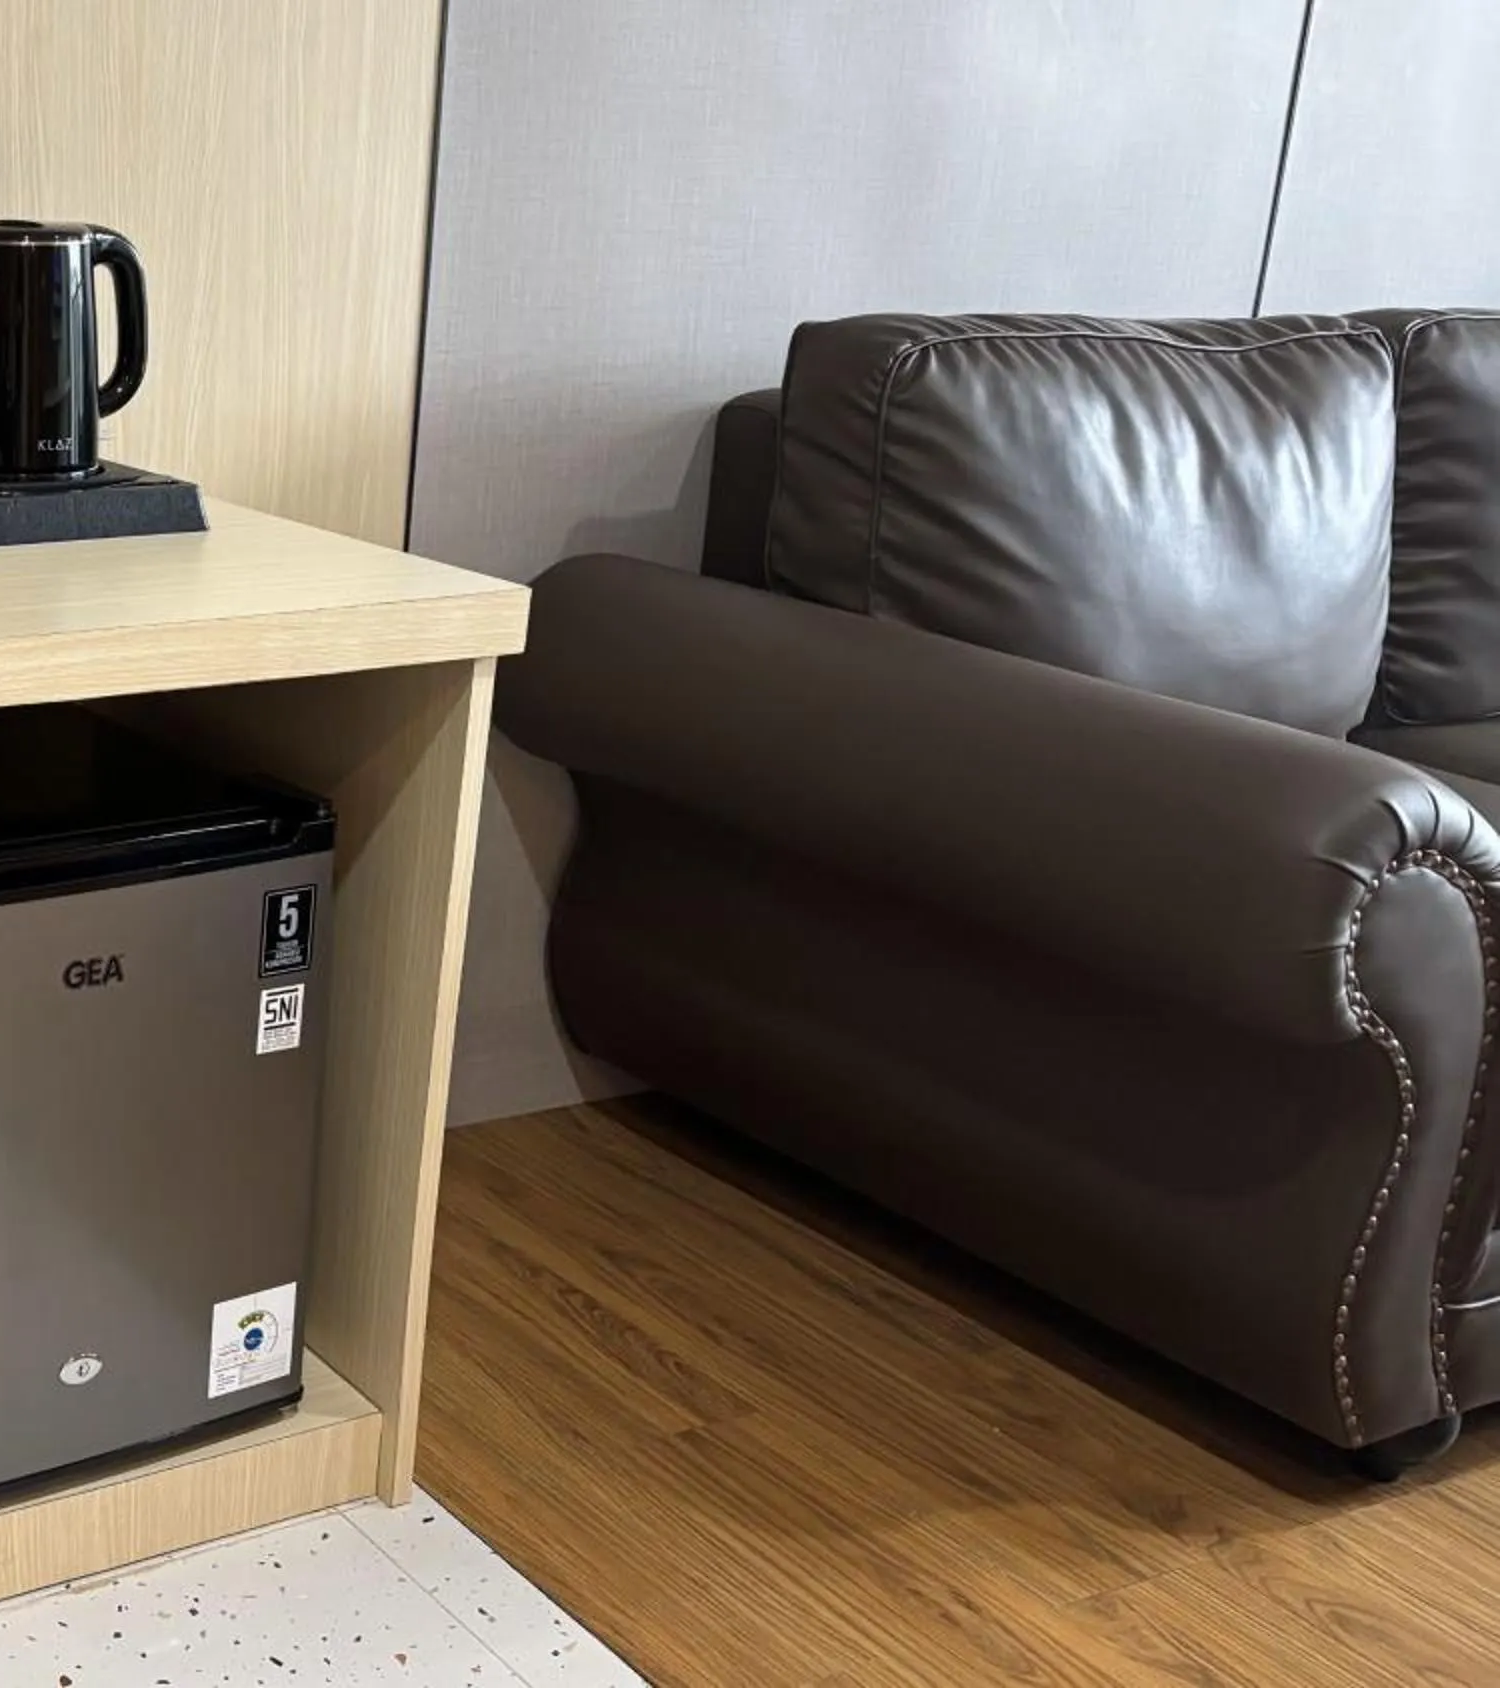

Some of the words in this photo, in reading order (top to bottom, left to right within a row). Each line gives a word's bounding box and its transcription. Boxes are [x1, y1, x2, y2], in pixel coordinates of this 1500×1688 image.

[279, 894, 299, 938] 5
[63, 954, 124, 989] GEA
[264, 995, 298, 1024] SNI
